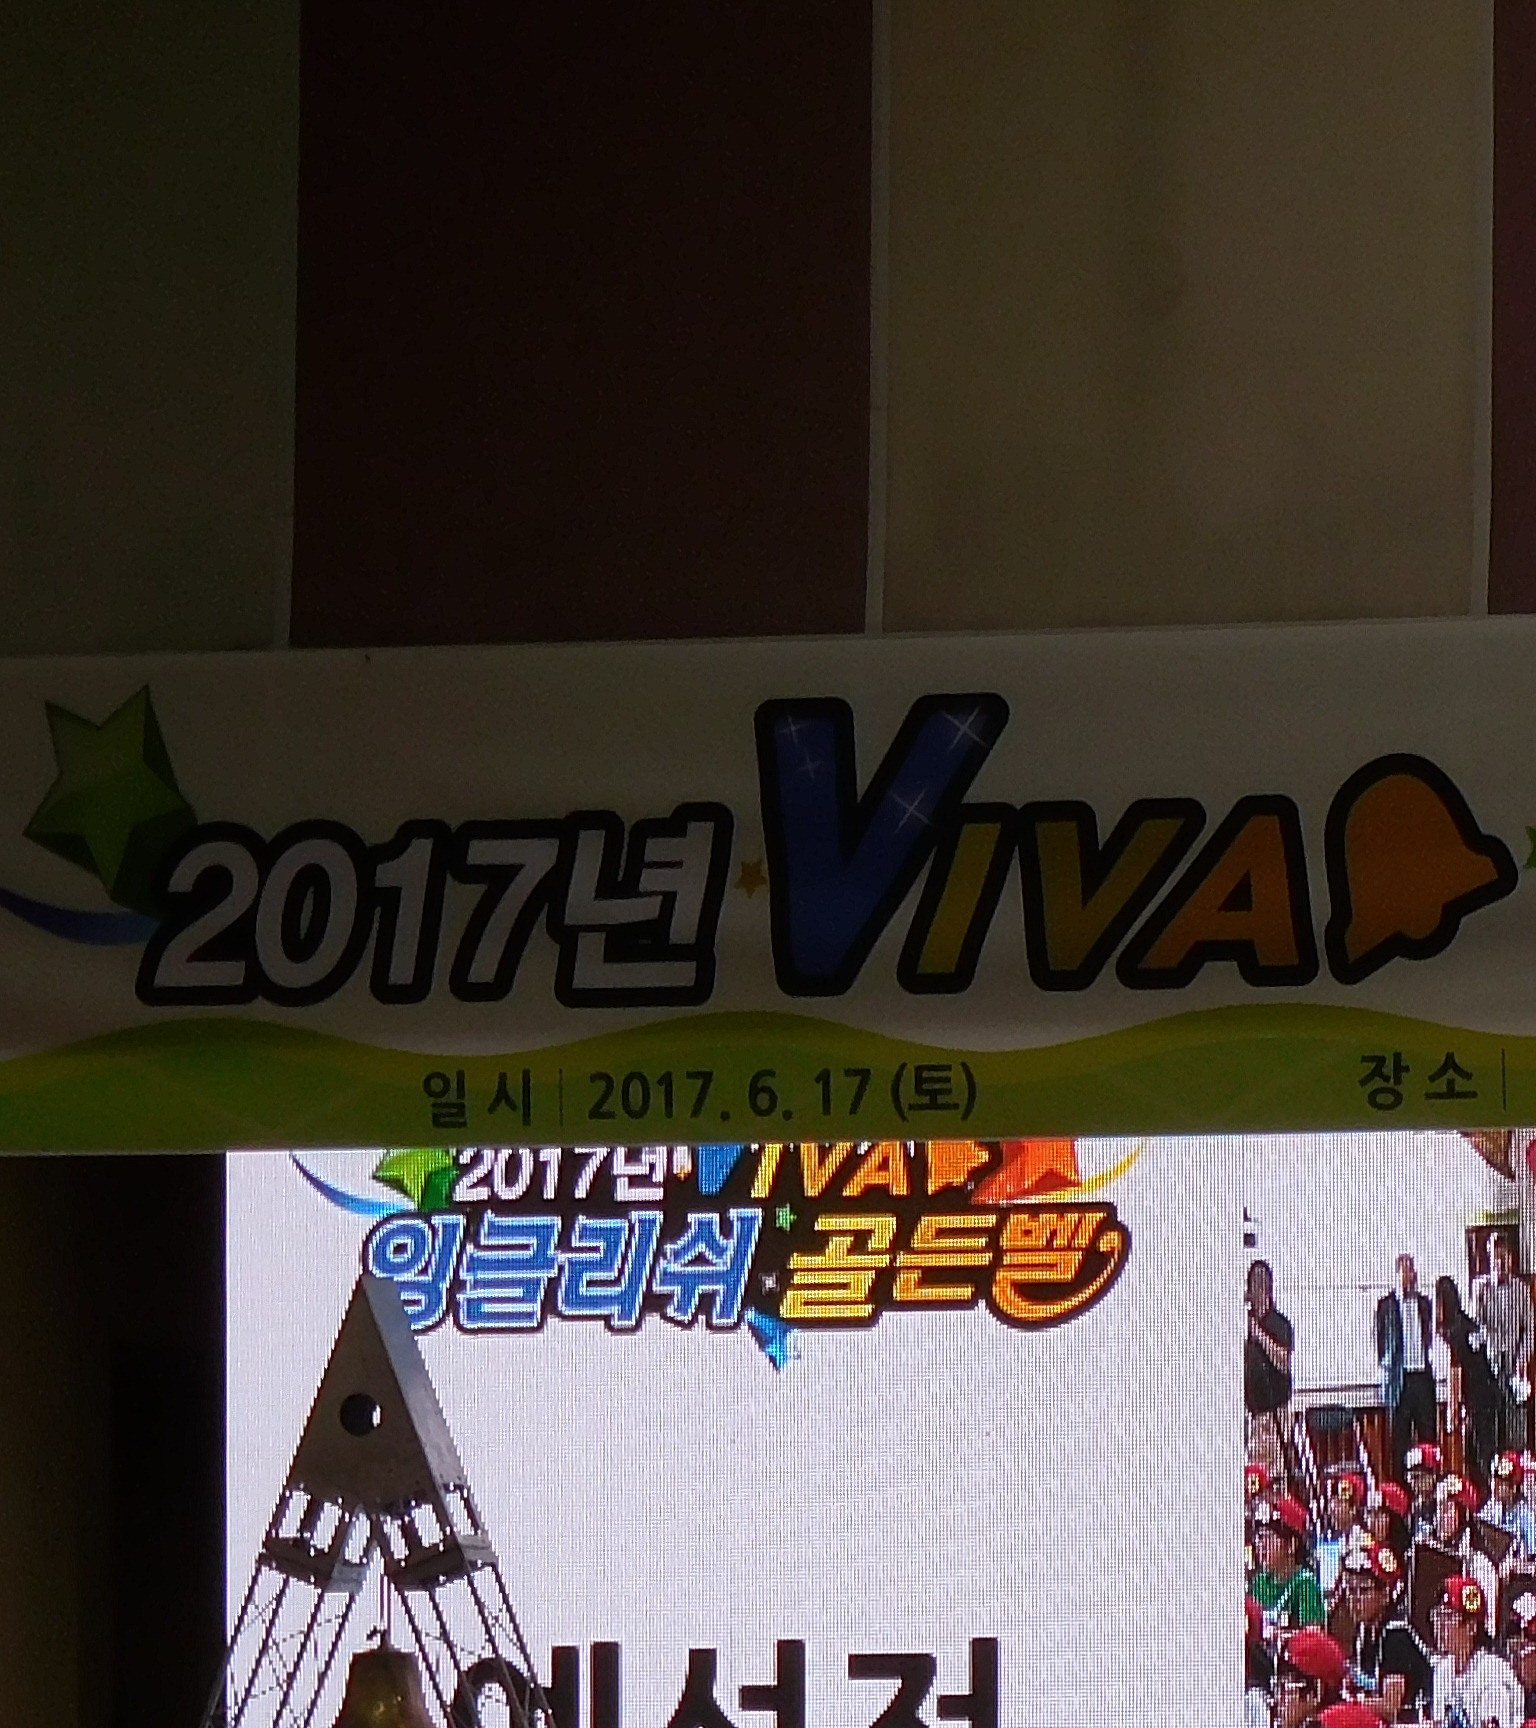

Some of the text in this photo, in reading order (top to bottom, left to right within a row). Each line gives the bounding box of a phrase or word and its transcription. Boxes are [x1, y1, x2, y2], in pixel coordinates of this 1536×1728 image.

[137, 802, 733, 1006] 2017년
[754, 693, 1319, 997] VIVA
[452, 1146, 667, 1202] 2017년
[362, 1202, 1132, 1332] 잉글리쉬 골든벨
